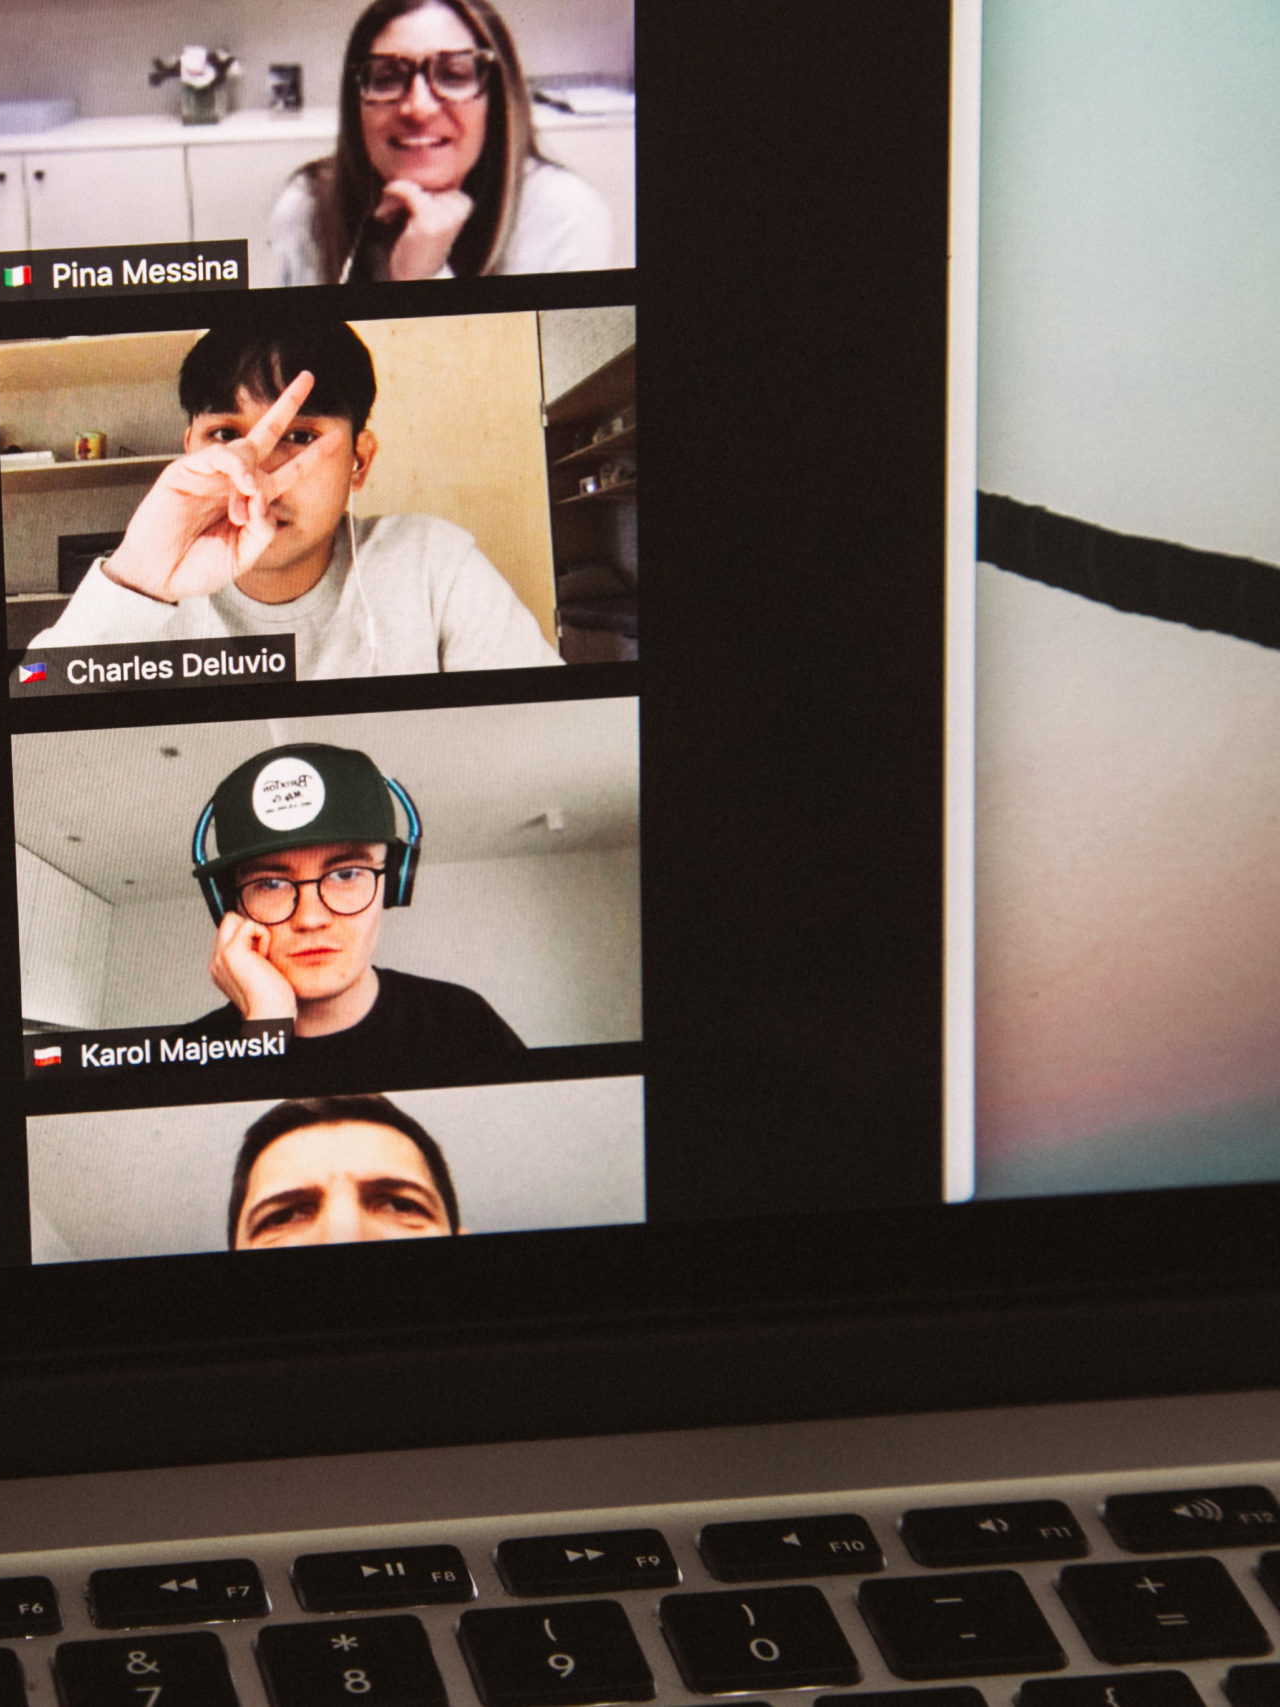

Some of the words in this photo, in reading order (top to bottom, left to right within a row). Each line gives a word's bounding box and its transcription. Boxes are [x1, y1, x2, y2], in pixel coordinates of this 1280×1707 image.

[52, 261, 113, 288] Pina
[122, 254, 239, 285] Messina
[67, 655, 173, 684] Charles
[182, 648, 286, 678] Deluvio
[81, 1039, 151, 1068] Karol
[160, 1030, 286, 1065] Majewski
[1239, 1511, 1278, 1524] F12
[1040, 1526, 1073, 1540] F11
[829, 1540, 866, 1554] F10
[636, 1555, 661, 1568] F9
[431, 1571, 457, 1583] F8
[227, 1585, 250, 1598] F7
[18, 1602, 45, 1615] F6
[125, 1651, 161, 1675] &
[547, 1653, 576, 1679] 9
[342, 1668, 372, 1694] 8
[135, 1685, 162, 1707] 7
